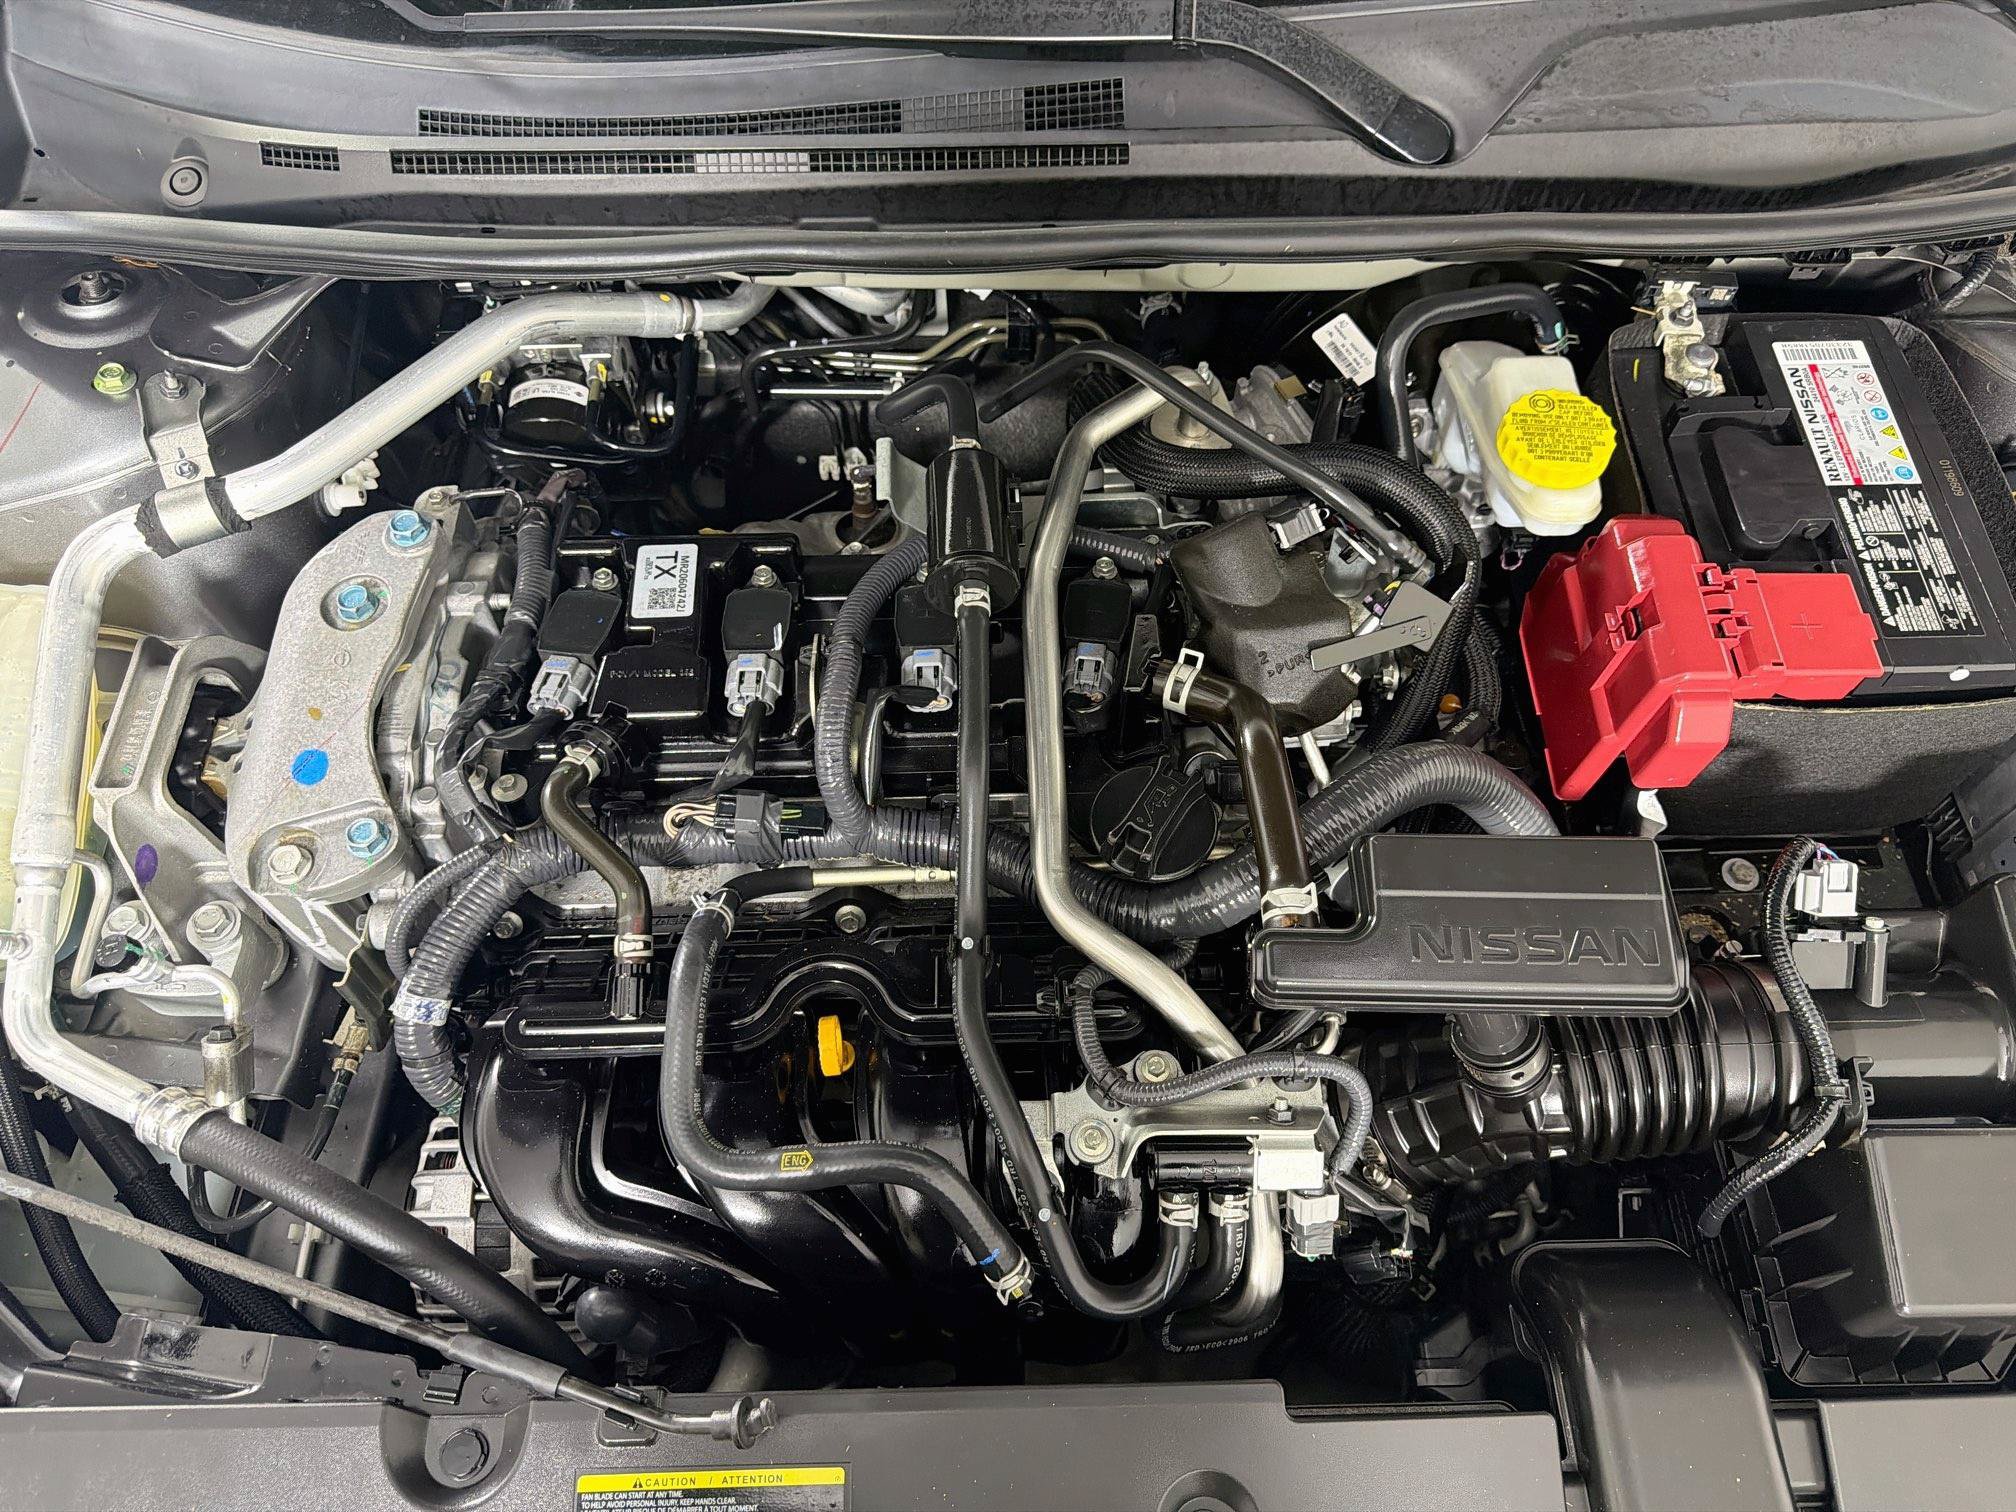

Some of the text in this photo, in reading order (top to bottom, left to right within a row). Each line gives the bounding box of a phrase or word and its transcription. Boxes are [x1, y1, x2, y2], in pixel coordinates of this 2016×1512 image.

[1786, 366, 1820, 424] NISSAN
[1809, 427, 1843, 482] RENAULT
[653, 550, 678, 580] TX
[1258, 651, 1269, 665] 2
[1408, 925, 1661, 966] NISSAN
[785, 1154, 808, 1167] ENG
[645, 1477, 696, 1487] CAUTION
[721, 1474, 783, 1485] ATTENTION
[594, 1492, 614, 1500] BLADE
[629, 1491, 646, 1499] START
[655, 1490, 668, 1498] ANY
[582, 1501, 590, 1509] TO
[591, 1501, 606, 1509] HELP
[606, 1500, 626, 1508] AVOID
[626, 1499, 657, 1508] PERSONAL
[695, 1497, 716, 1505] HANDS
